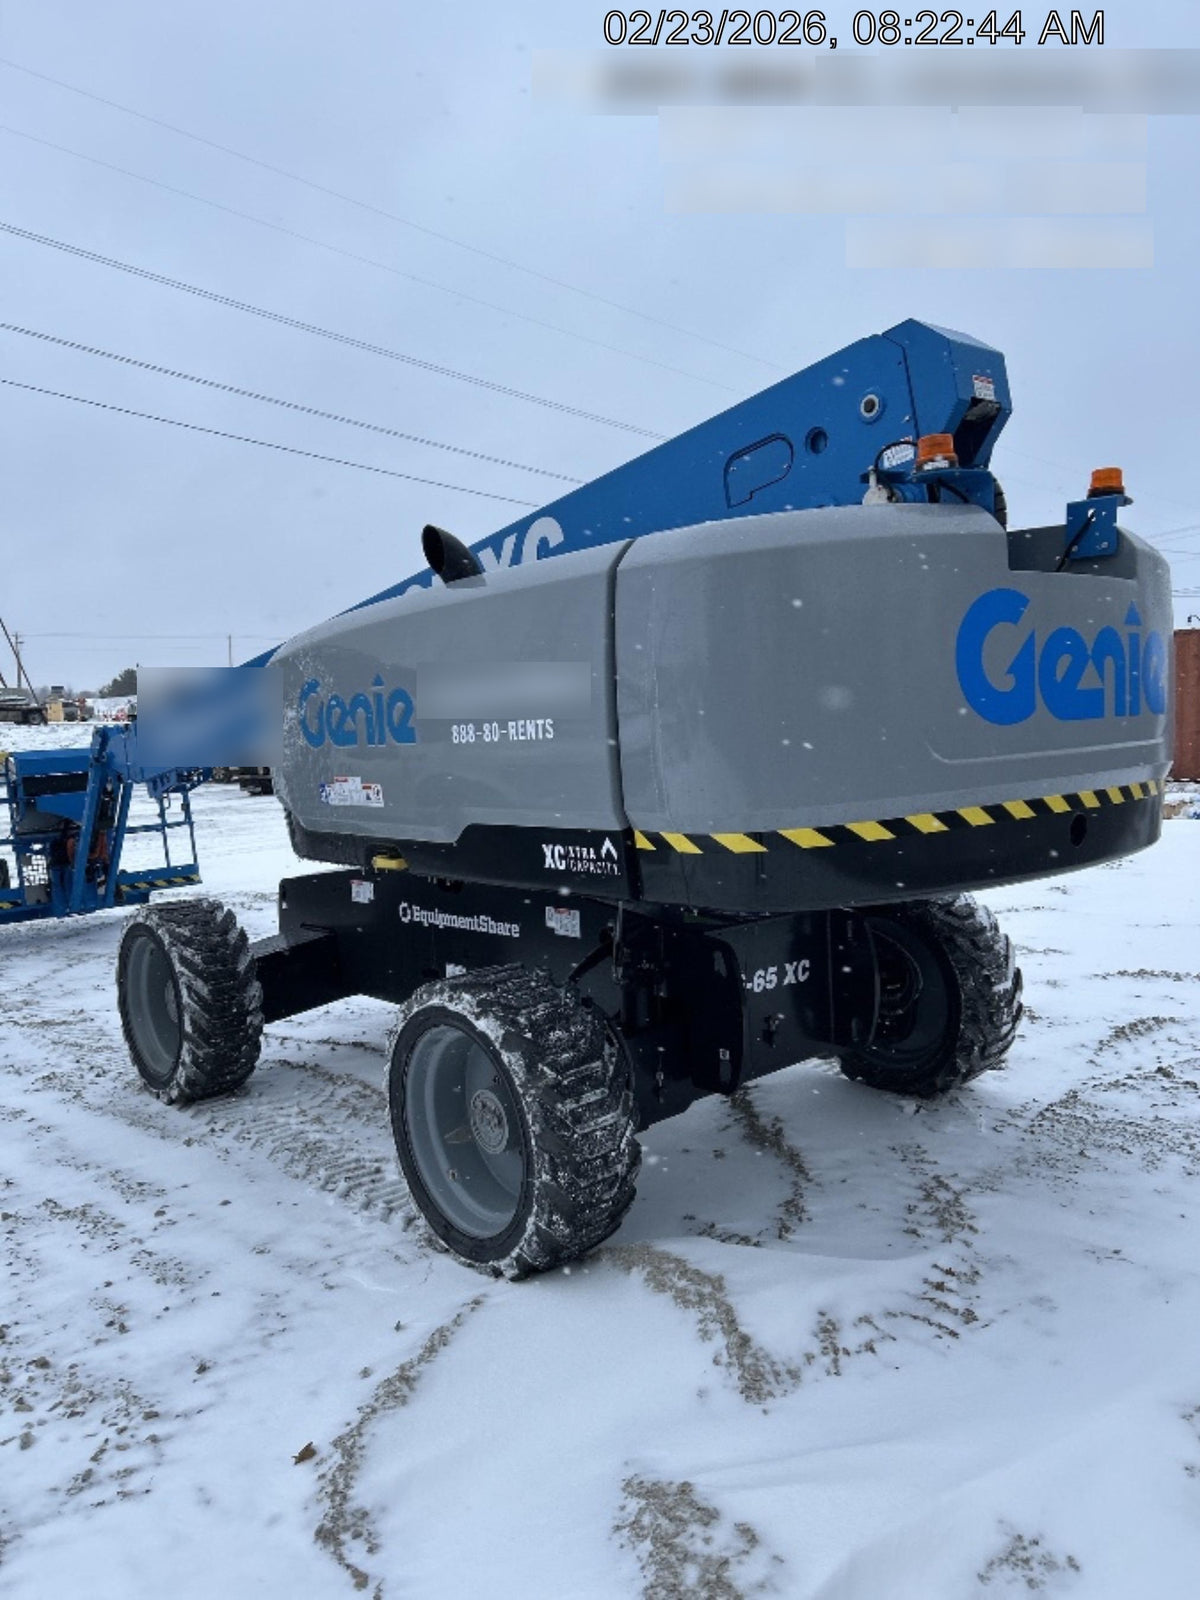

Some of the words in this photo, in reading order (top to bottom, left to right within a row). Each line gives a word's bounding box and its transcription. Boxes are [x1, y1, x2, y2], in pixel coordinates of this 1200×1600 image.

[956, 587, 1167, 726] Genie
[298, 673, 417, 749] Genie
[451, 718, 555, 744] 888-80-RENTS
[541, 843, 566, 870] XC
[411, 905, 521, 938] EquipmentShare
[740, 965, 778, 993] -65
[782, 958, 810, 986] XC
